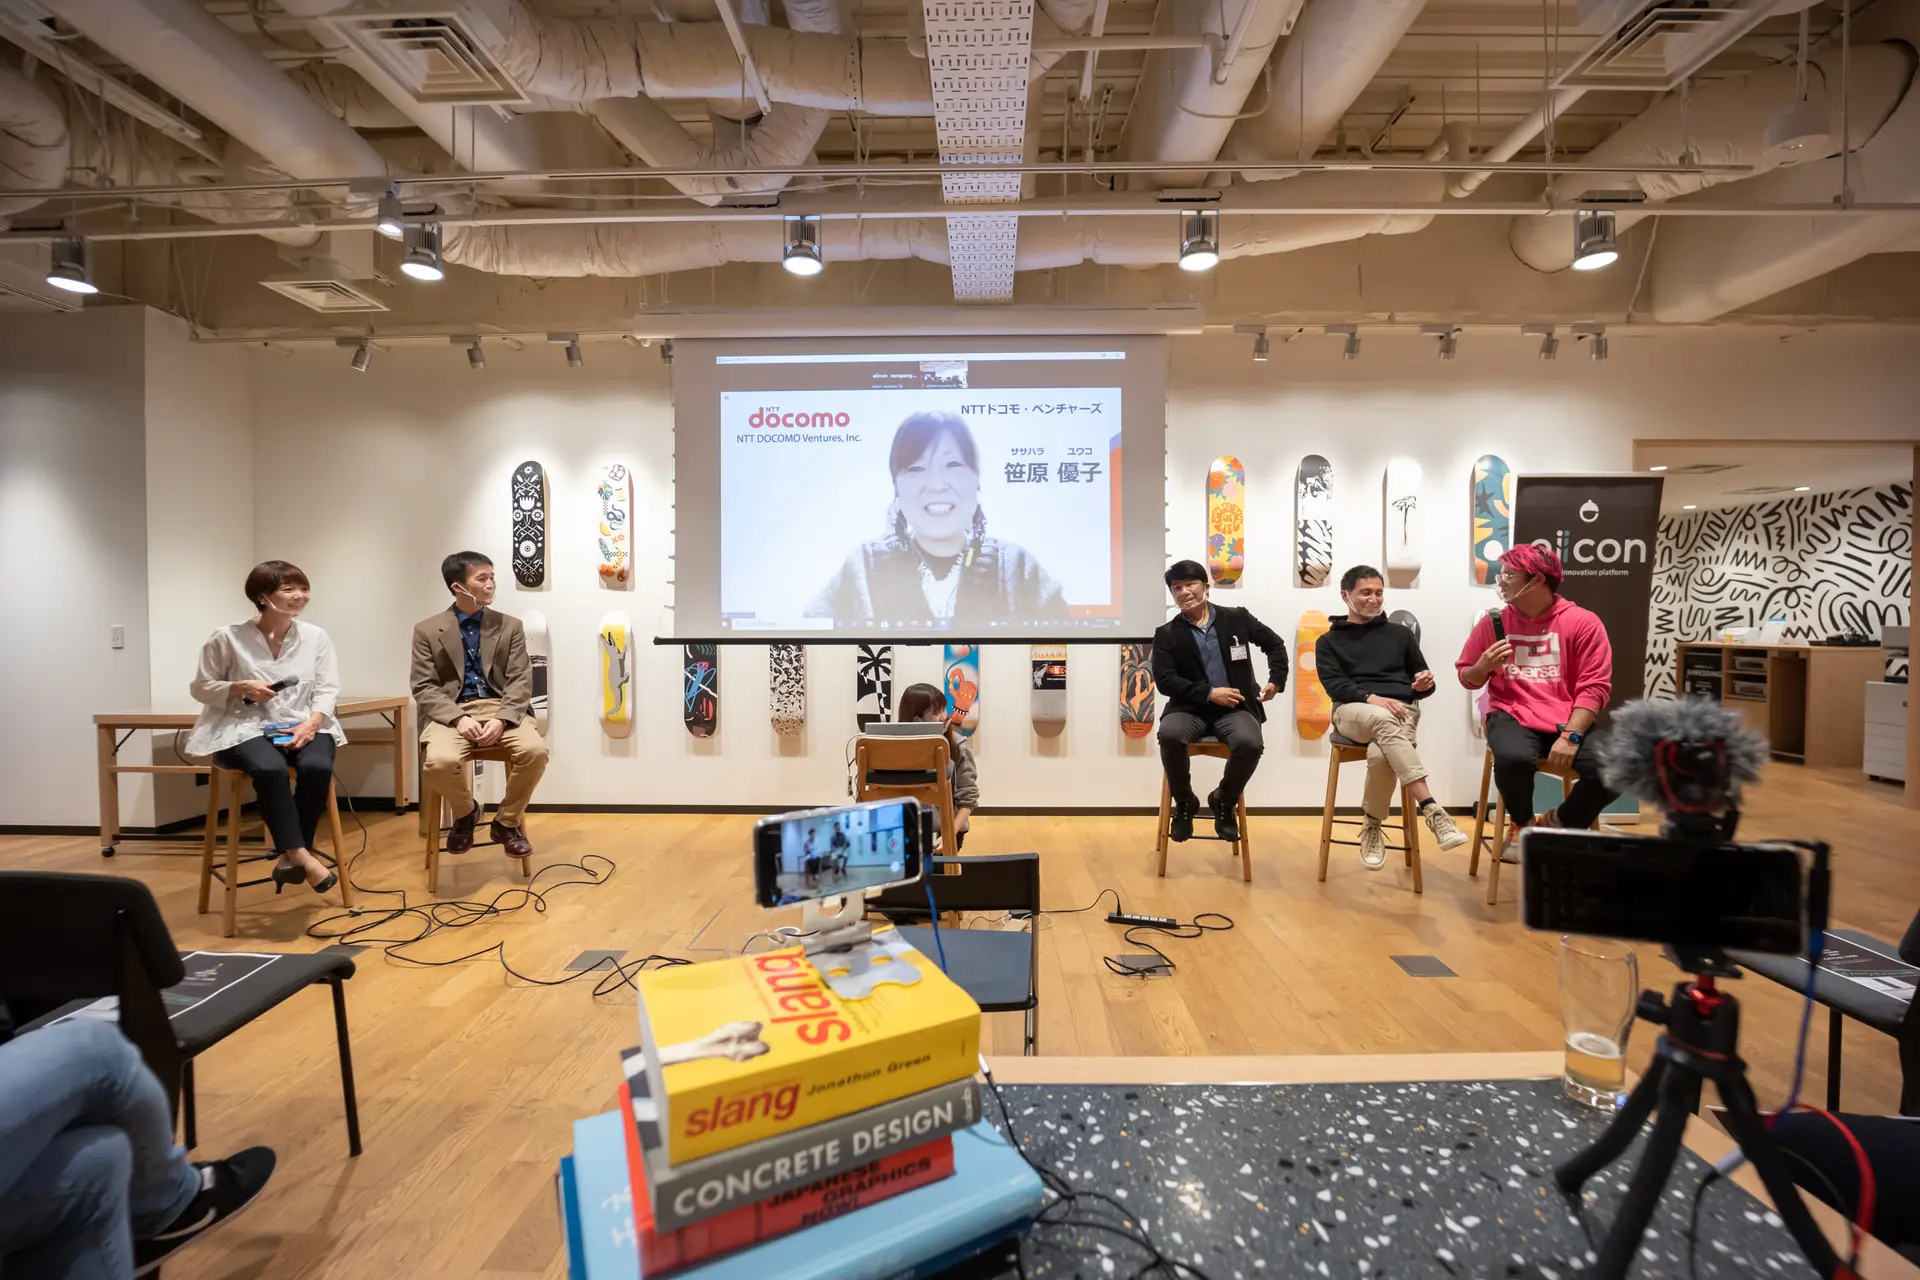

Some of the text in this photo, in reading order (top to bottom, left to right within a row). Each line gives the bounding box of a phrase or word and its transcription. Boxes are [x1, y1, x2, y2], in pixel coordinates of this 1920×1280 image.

[748, 406, 851, 429] docomo
[960, 403, 1102, 415] NTTドコモ・ベンチャーズ
[736, 433, 862, 443] NTT DOCOMO Ventures, Inc.
[1010, 447, 1093, 456] ササハラ ユウコ
[1004, 462, 1103, 484] 笹原 優子
[1599, 568, 1629, 577] platform
[684, 1082, 801, 1139] slang
[806, 1068, 882, 1097] Jonathon
[887, 1053, 932, 1074] Green
[672, 1100, 954, 1217] CONCRETE DESIGN
[767, 1159, 882, 1208] JAPANESE
[821, 1156, 932, 1207] GRAPHICS
